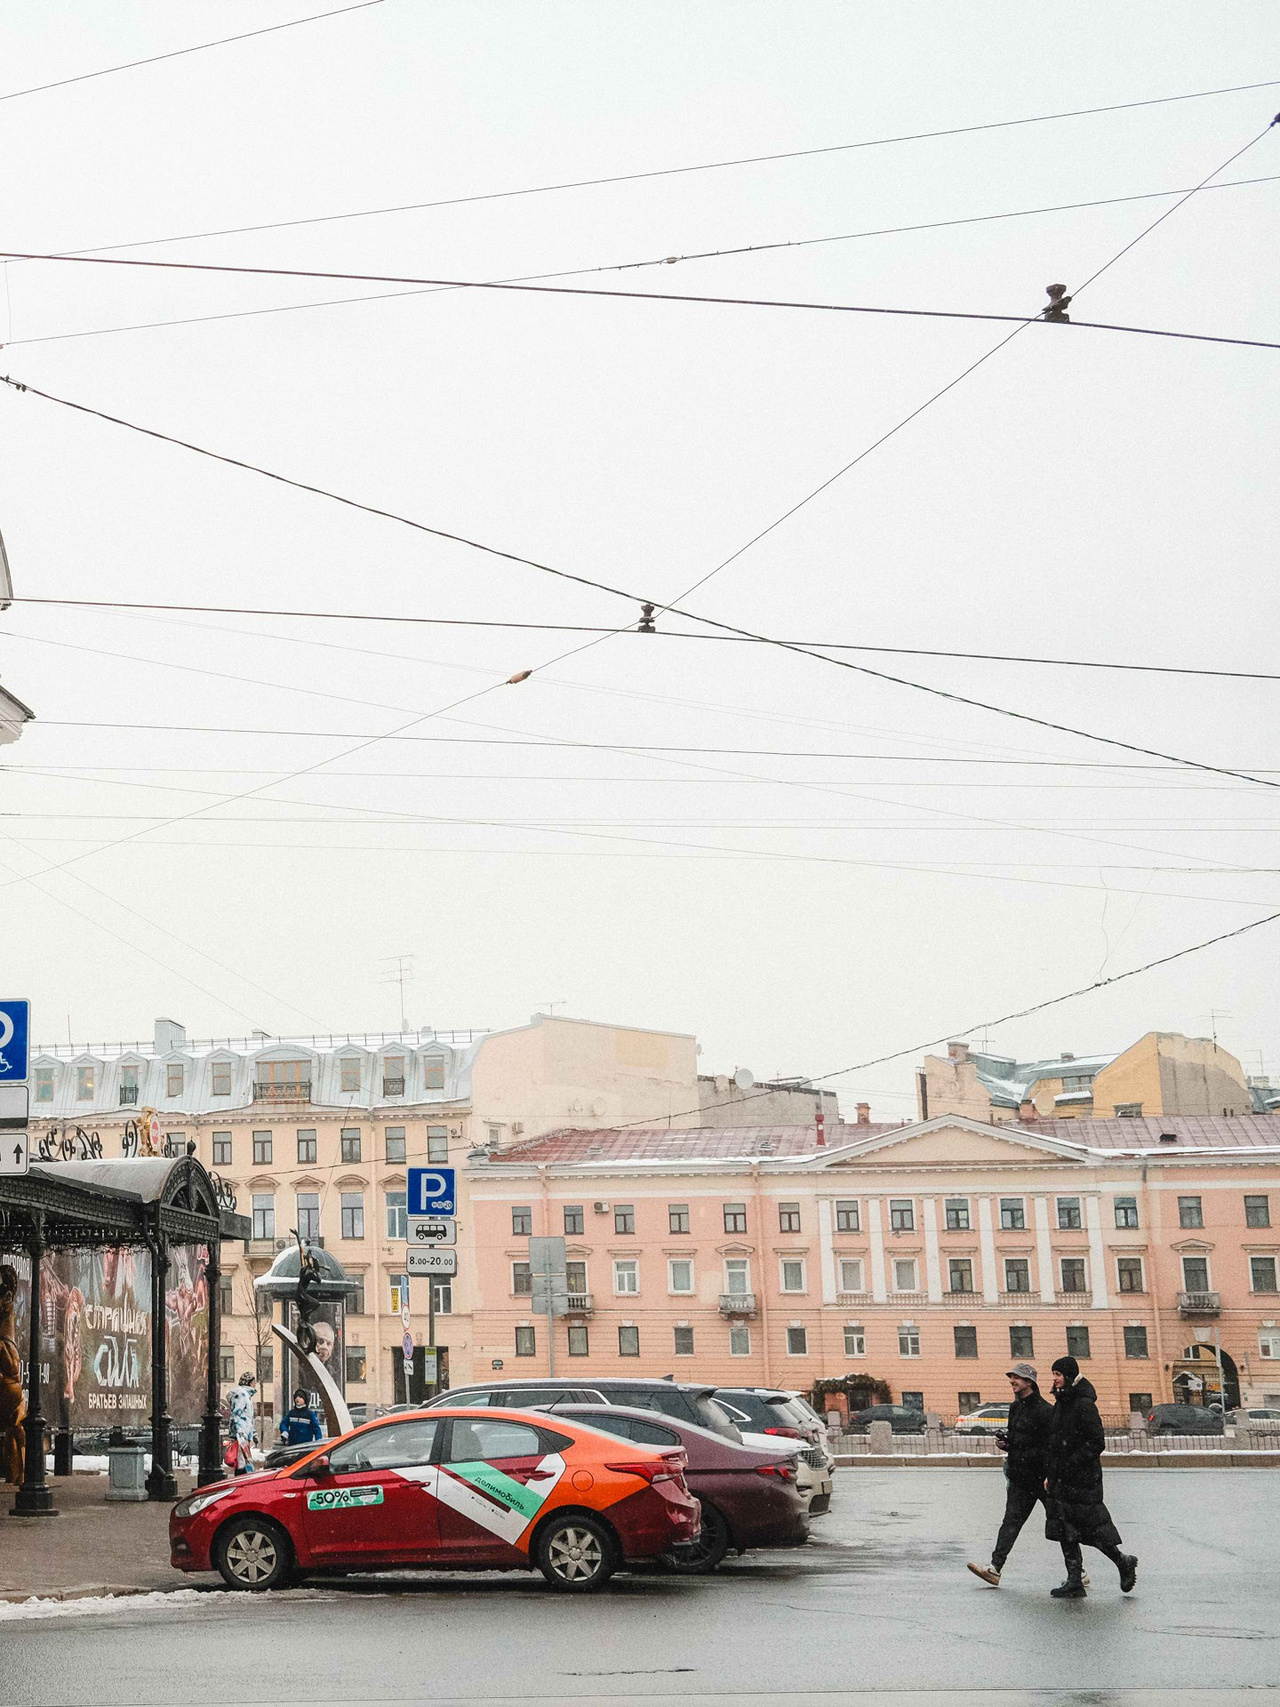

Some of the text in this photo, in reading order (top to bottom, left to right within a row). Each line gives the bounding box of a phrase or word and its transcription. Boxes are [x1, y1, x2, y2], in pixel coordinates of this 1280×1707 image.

[420, 1173, 447, 1211] P
[88, 1393, 117, 1410] БРАТЬЕВ
[310, 1491, 349, 1505] -50%
[473, 1476, 525, 1511] делимобиль
